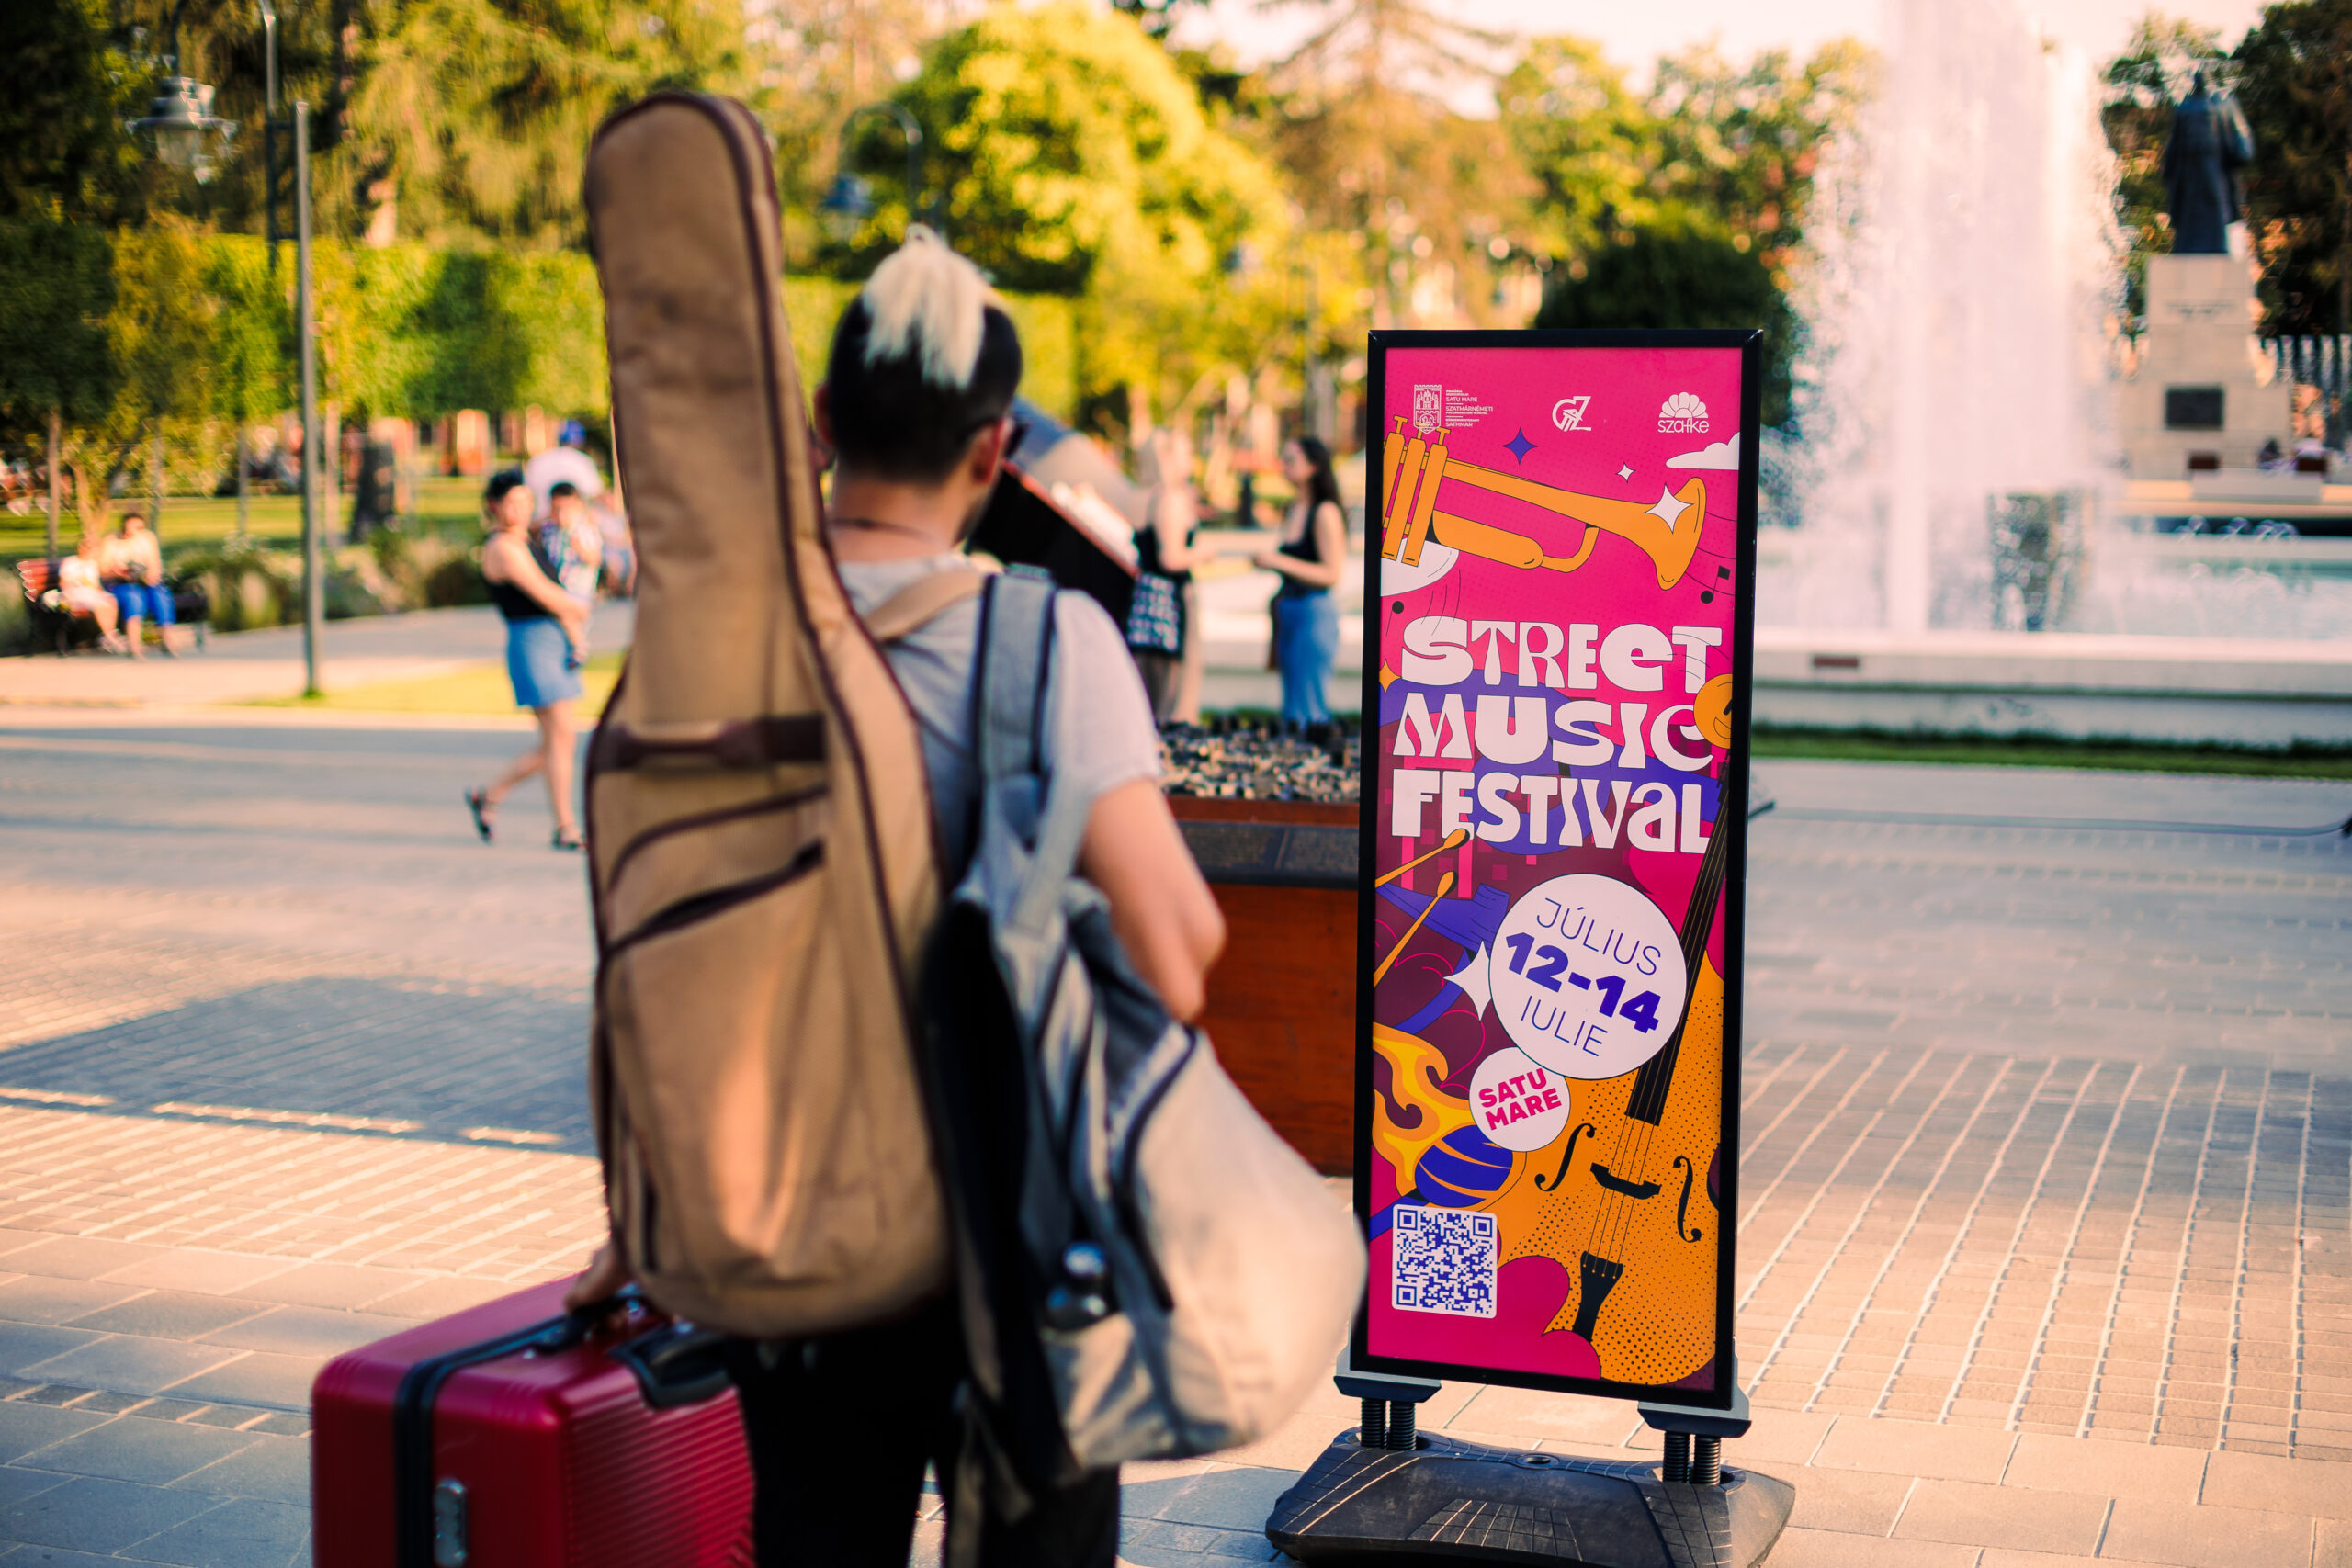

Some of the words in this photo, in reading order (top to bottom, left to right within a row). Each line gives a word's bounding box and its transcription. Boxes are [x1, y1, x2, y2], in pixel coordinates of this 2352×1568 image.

[1392, 692, 1713, 772] MUSIC
[1536, 897, 1661, 976] JÚLIUS
[1505, 931, 1662, 1034] 12-14
[1521, 995, 1609, 1057] IULIE
[1478, 1067, 1547, 1108] SATU
[1485, 1088, 1562, 1131] MARE
